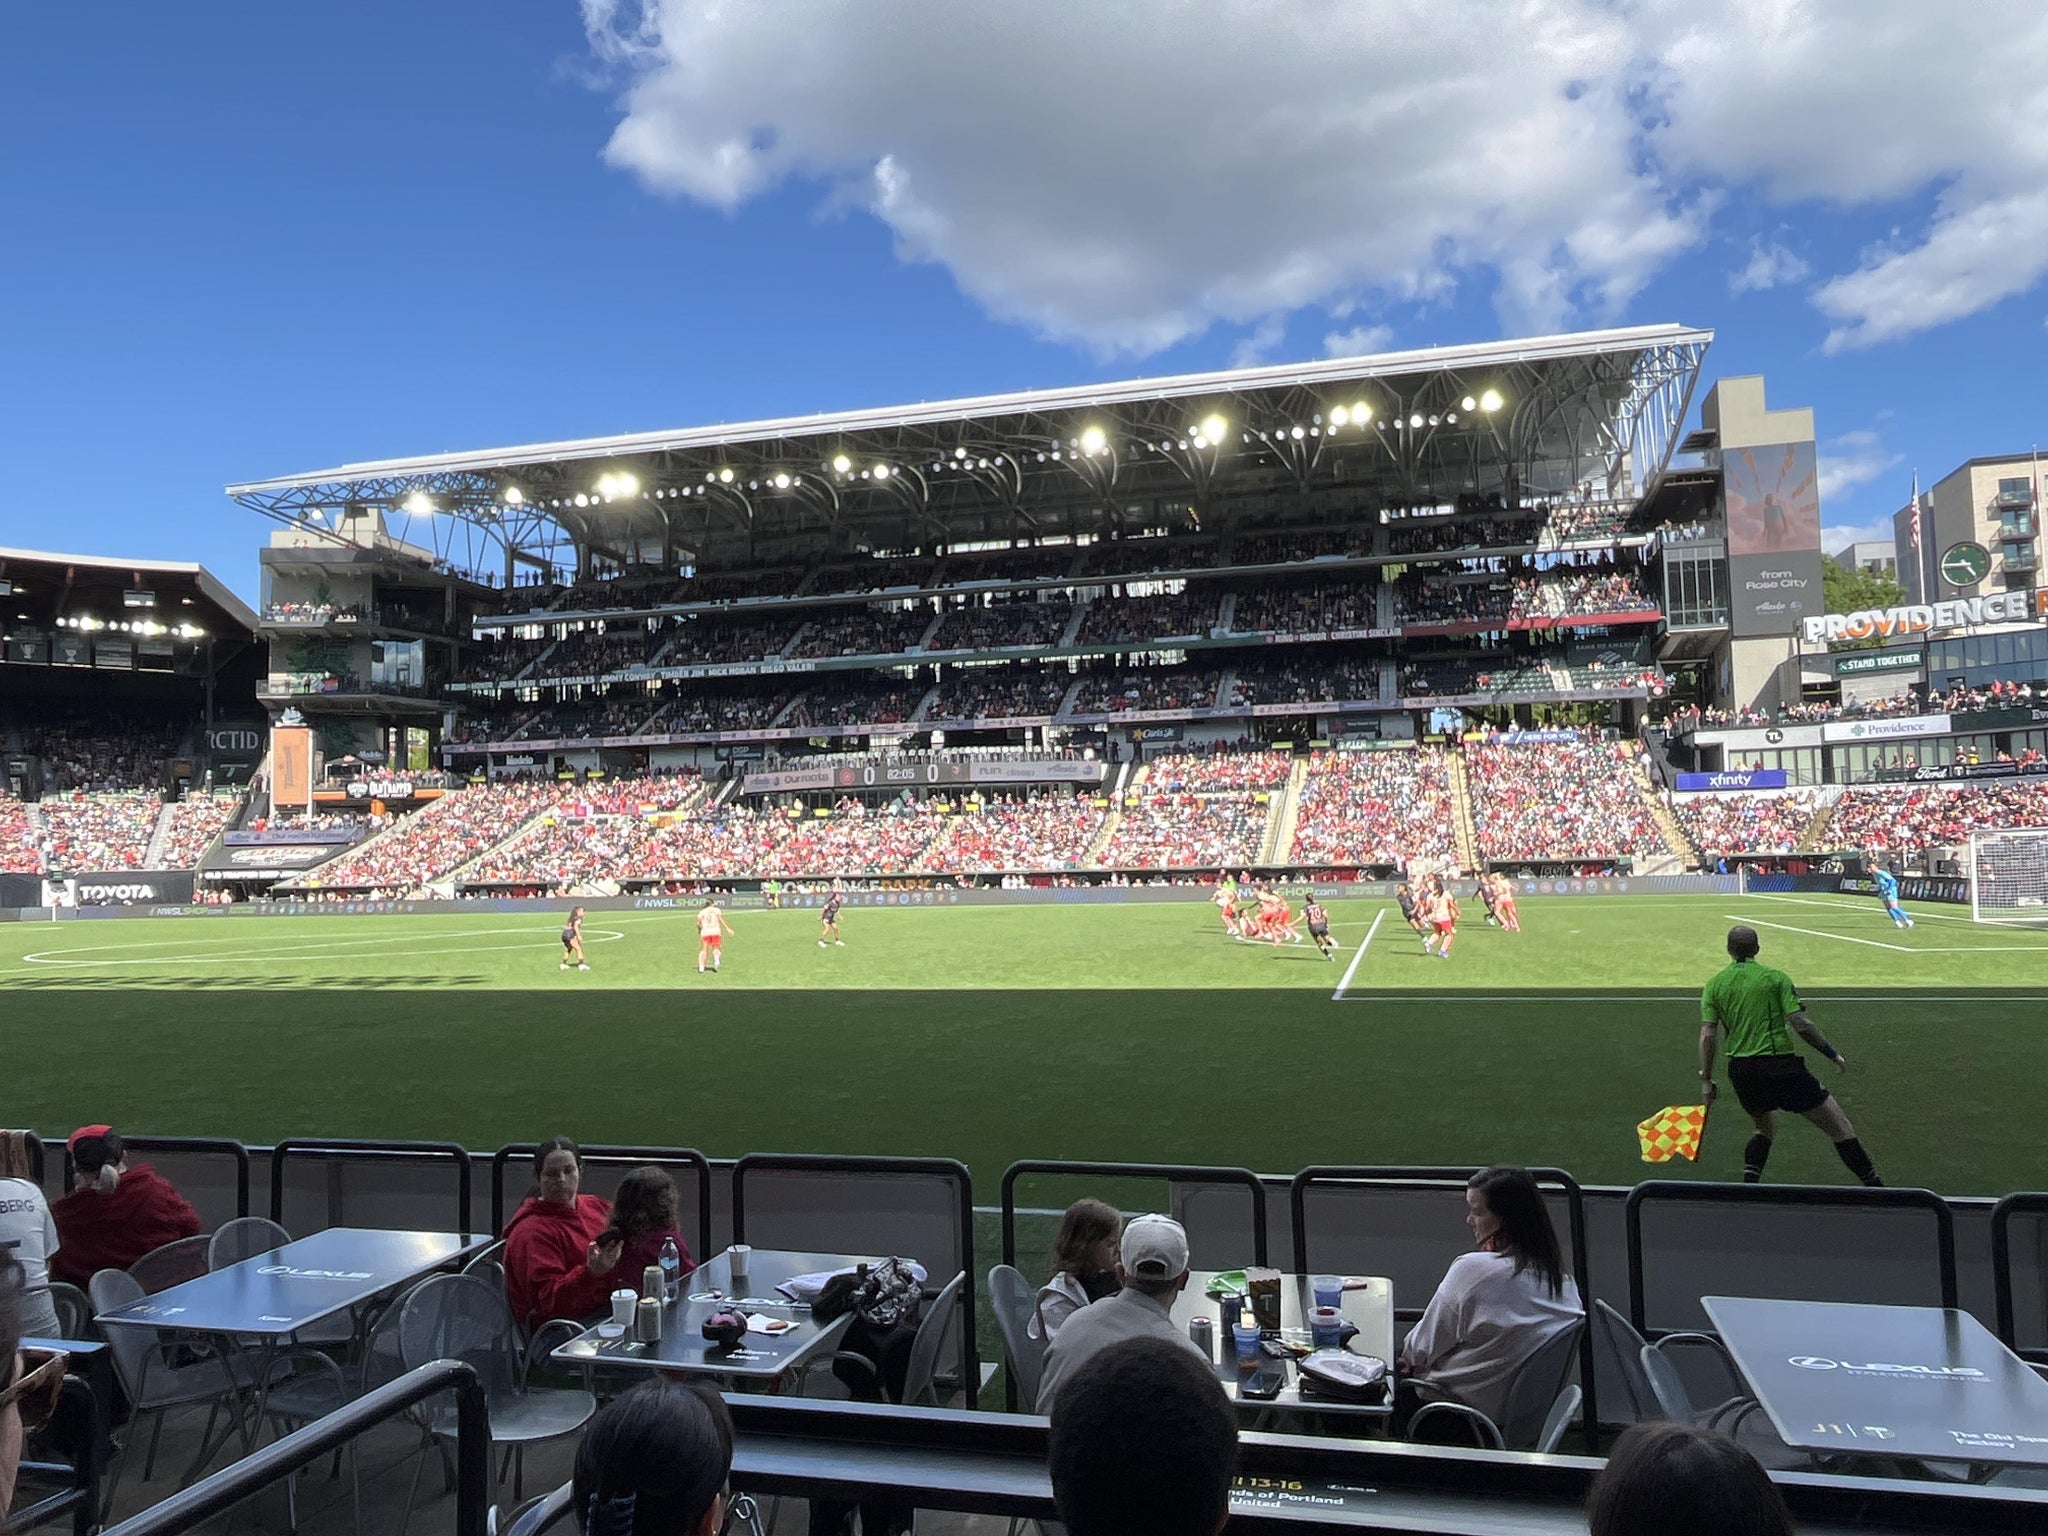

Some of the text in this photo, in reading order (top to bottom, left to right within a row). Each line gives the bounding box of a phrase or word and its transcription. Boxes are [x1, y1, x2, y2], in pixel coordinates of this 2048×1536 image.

[1760, 570, 1792, 579] from
[1746, 579, 1808, 590] Rose City
[1803, 590, 2028, 643] PROVIDENCE
[787, 661, 815, 672] VALERI
[1848, 653, 1920, 670] STAND TOGETHER
[1766, 731, 1782, 741] TL
[1868, 722, 1926, 736] Providence
[863, 767, 915, 785] 0 82:05
[927, 764, 939, 782] 0
[1914, 765, 1948, 780] Ford
[1709, 774, 1752, 788] xfinity
[80, 885, 154, 899] TOYOTA
[1309, 908, 1322, 919] 20
[0, 1200, 35, 1214] BERG
[1840, 1361, 1985, 1377] LEXUS
[1250, 1477, 1303, 1491] 13-16
[1230, 1497, 1281, 1508] United
[1258, 1491, 1274, 1499] of
[1279, 1492, 1344, 1505] Portland
